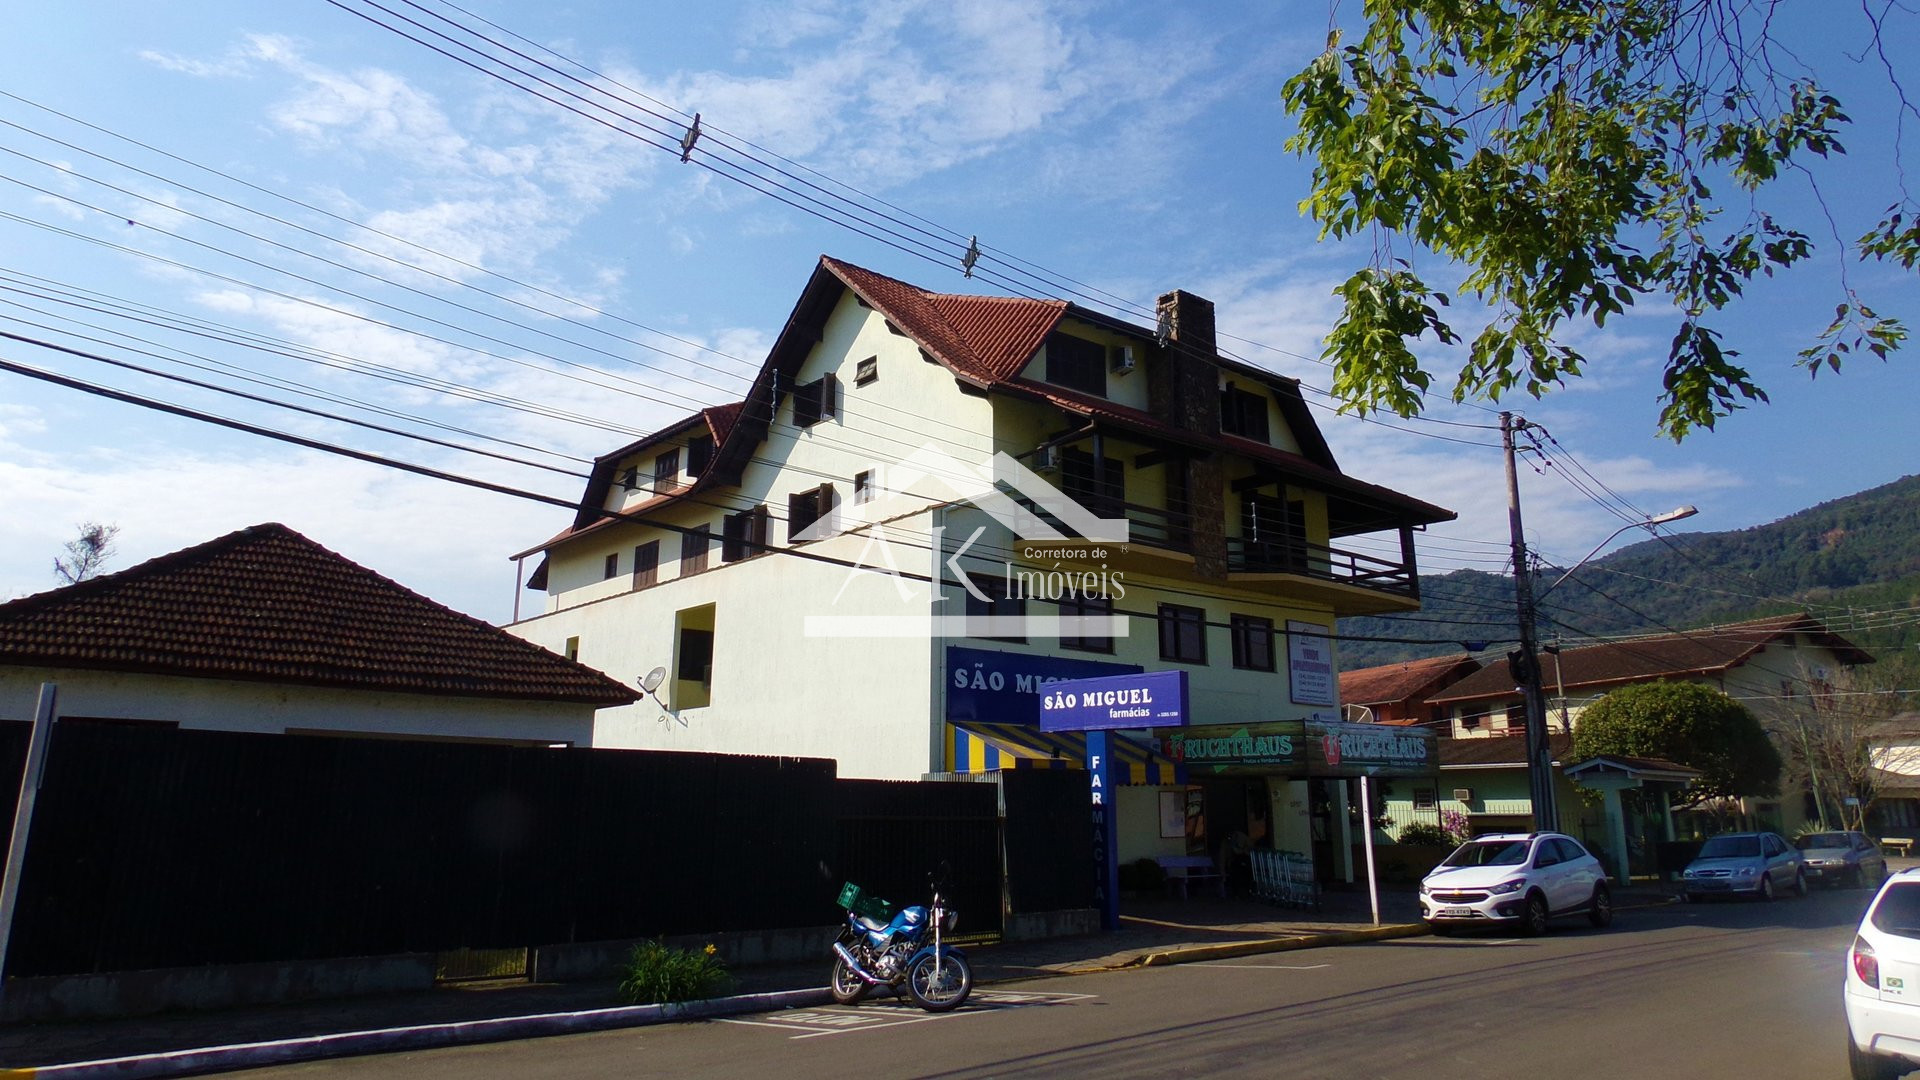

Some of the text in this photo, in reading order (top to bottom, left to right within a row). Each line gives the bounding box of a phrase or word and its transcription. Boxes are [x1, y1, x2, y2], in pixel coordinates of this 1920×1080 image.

[954, 662, 1005, 691] SÃO
[1044, 688, 1153, 710] SÃO MIGUEL
[1109, 707, 1151, 719] farmácias
[1168, 733, 1293, 759] FRUCHTHAUS
[1326, 728, 1427, 760] FRUCHTHAUS
[1091, 755, 1105, 901] FARMÁCIA
